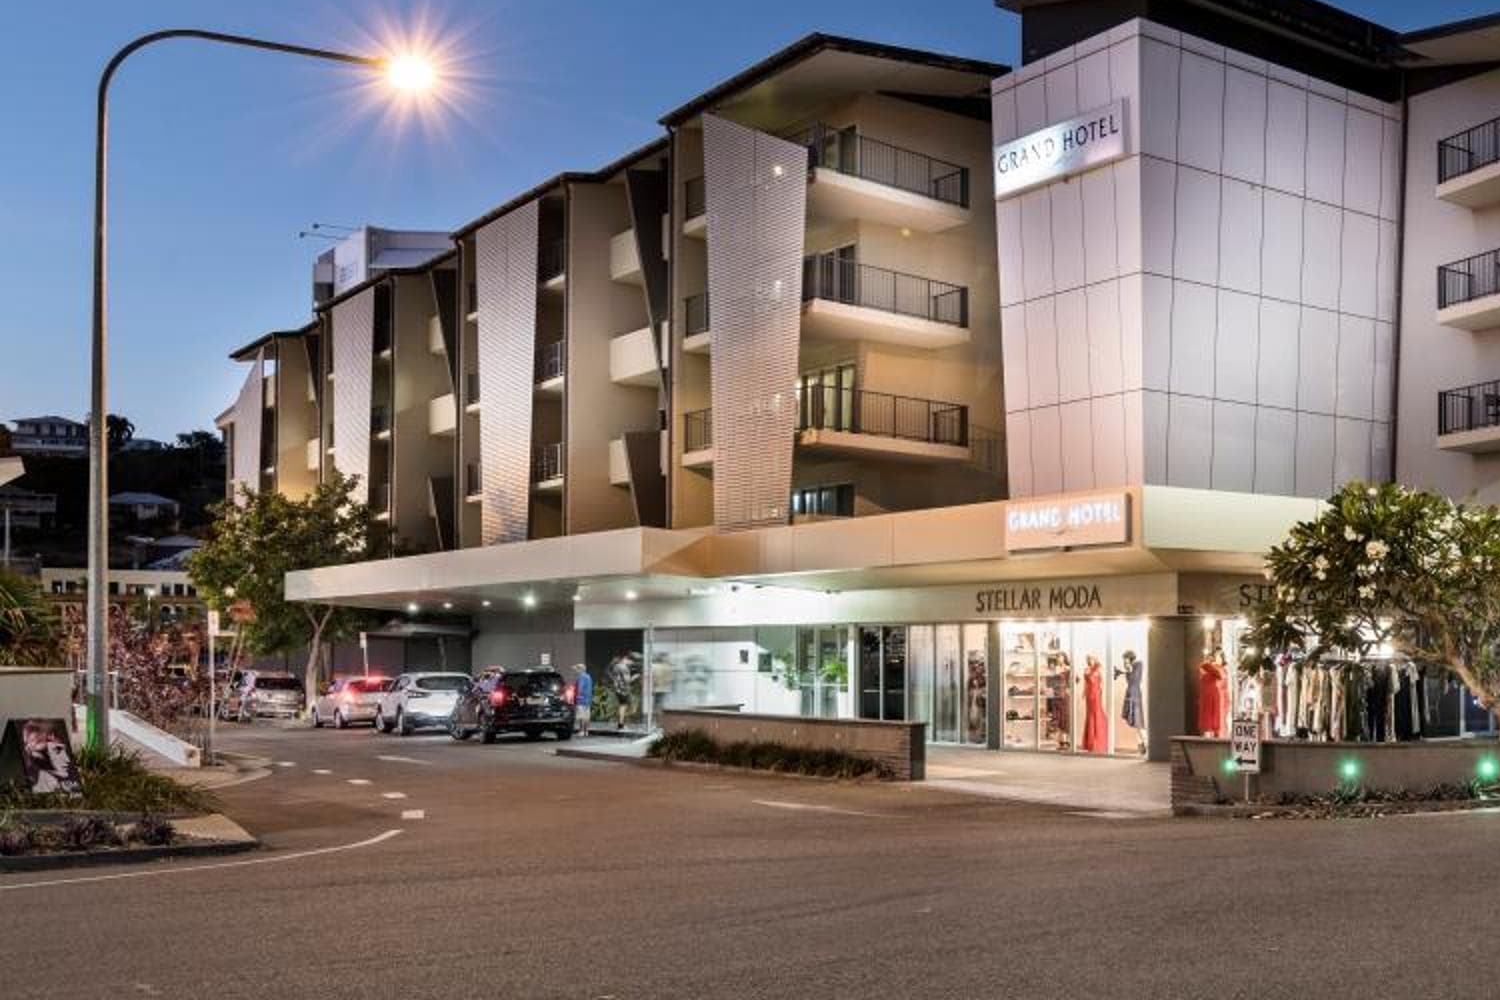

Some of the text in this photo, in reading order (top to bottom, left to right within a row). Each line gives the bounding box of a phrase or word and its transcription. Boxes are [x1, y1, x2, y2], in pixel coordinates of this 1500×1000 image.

[997, 115, 1119, 174] GRAND HOTEL
[1007, 500, 1122, 531] GRAND HOTEL
[976, 584, 1103, 613] STELLAR MODA
[1235, 725, 1257, 738] ONE
[1234, 741, 1257, 752] WAY
